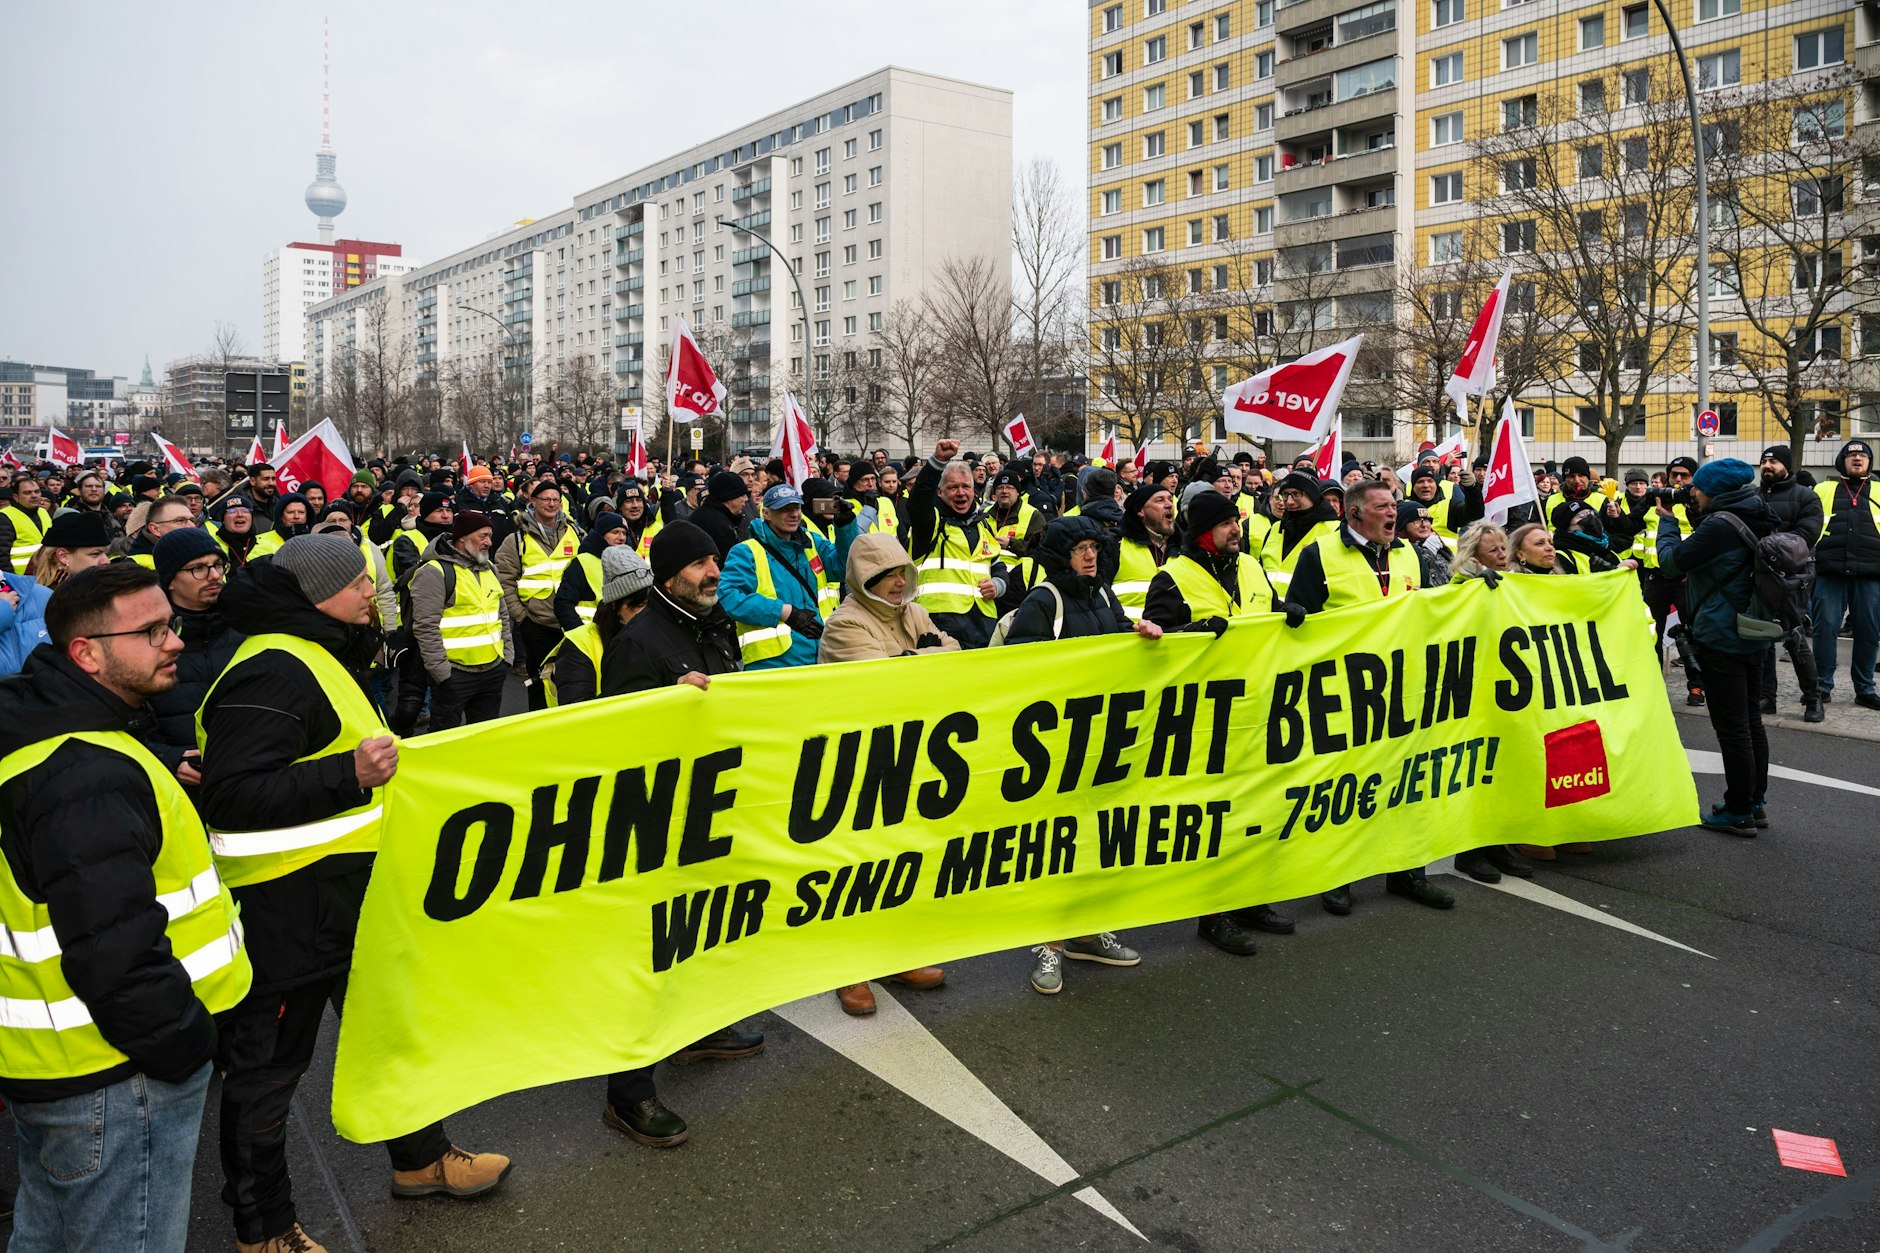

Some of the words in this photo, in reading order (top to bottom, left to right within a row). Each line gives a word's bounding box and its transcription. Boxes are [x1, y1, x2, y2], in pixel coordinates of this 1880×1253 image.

[424, 746, 742, 921] OHNE
[788, 711, 979, 844] UNS
[1001, 679, 1246, 802] STEHT
[1267, 636, 1477, 765] BERLIN
[1495, 620, 1630, 712] STILL
[652, 879, 771, 973] WIR
[786, 852, 923, 927] SIND
[934, 816, 1078, 899] MEHR
[1098, 801, 1231, 869] WERT
[1246, 825, 1262, 837] -
[1279, 773, 1382, 841] 750€
[1387, 737, 1500, 809] JETZT!
[1551, 766, 1604, 790] ver.di
